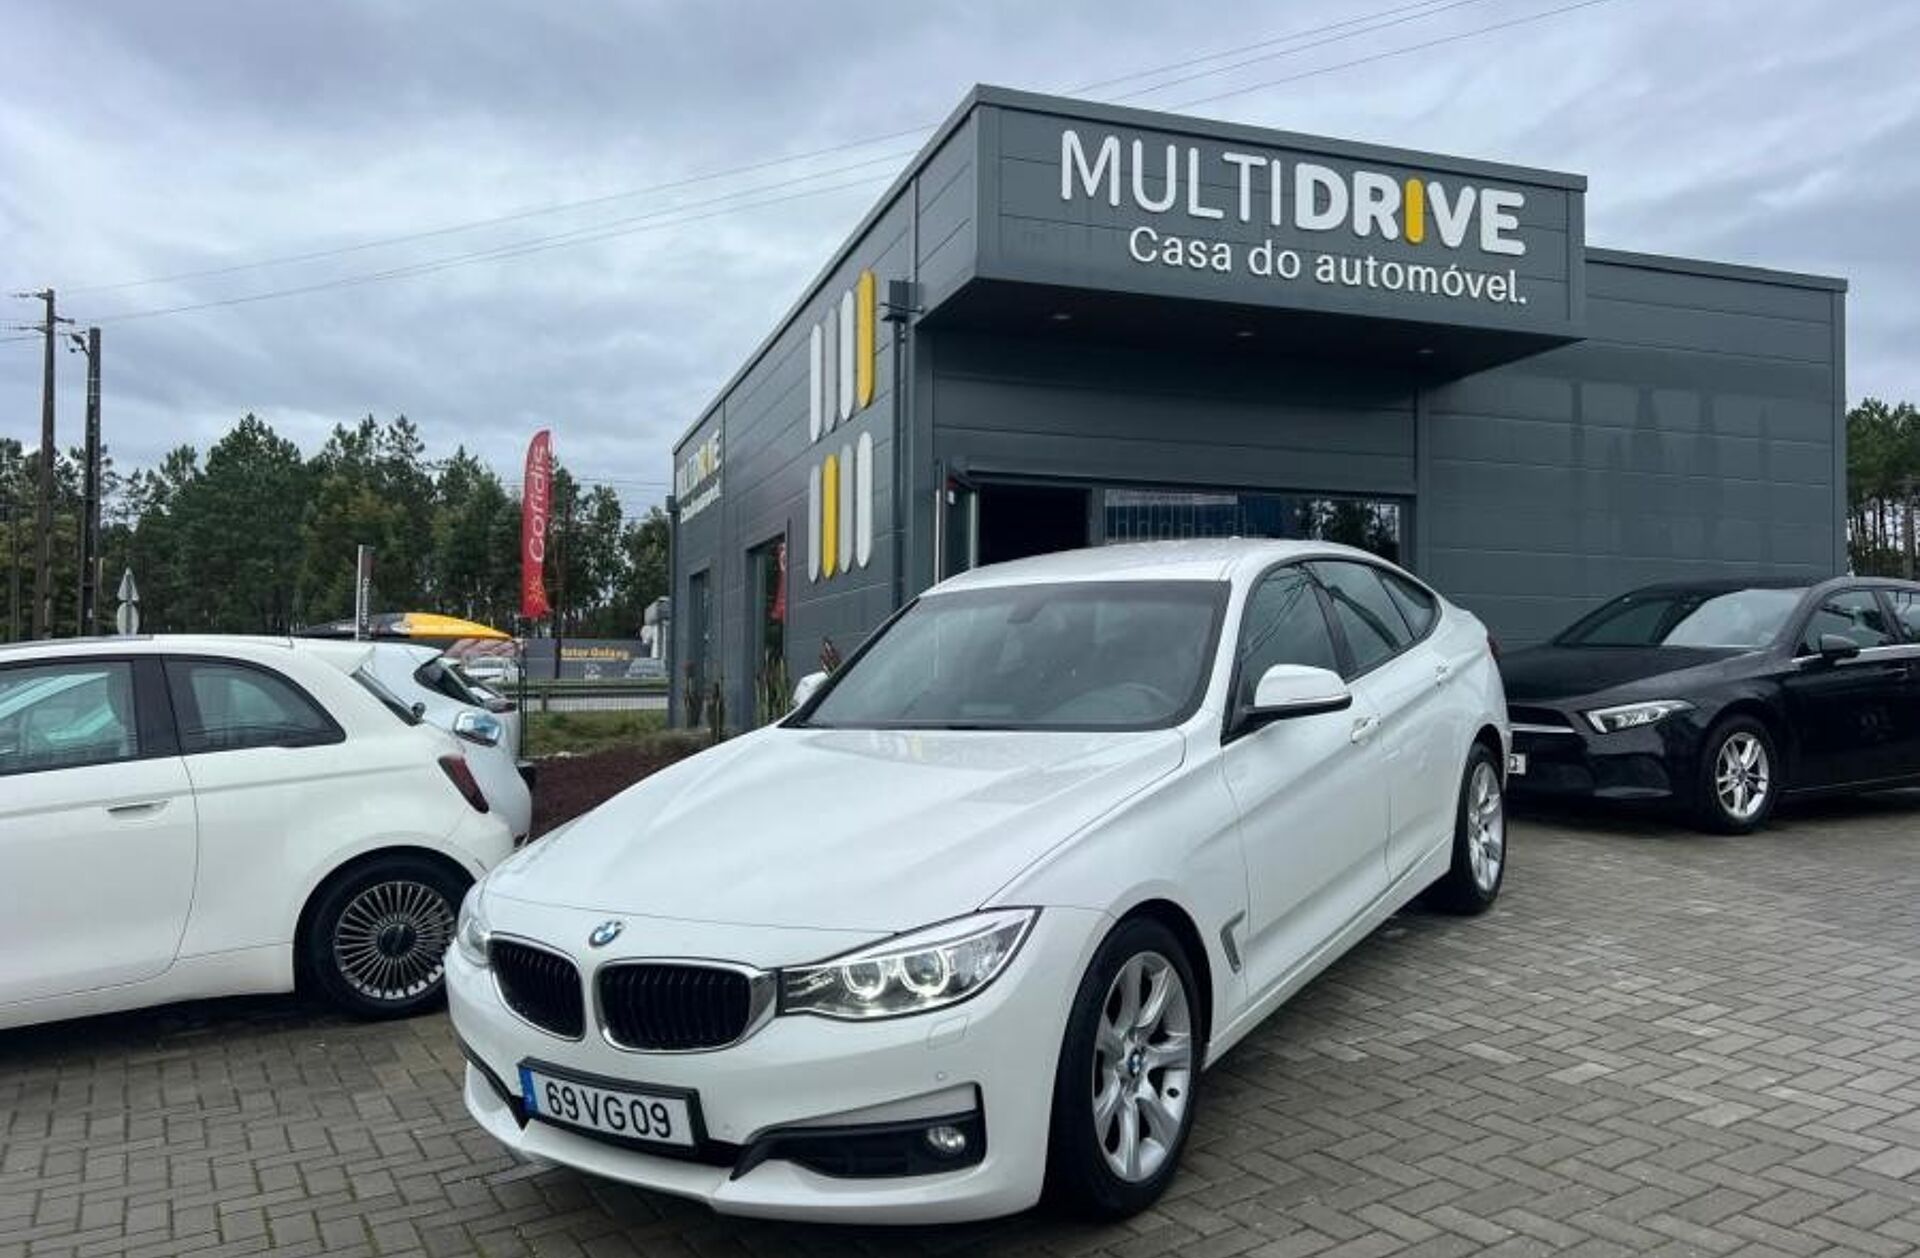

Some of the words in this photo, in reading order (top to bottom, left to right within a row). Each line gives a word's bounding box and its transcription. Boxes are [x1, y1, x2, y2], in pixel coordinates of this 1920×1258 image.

[1060, 129, 1526, 255] MULTIDRIVE
[1128, 226, 1233, 272] Casa
[1247, 239, 1301, 279] do
[1314, 254, 1528, 305] automóvel.
[528, 443, 546, 563] Cofidis
[544, 1080, 671, 1138] 69VG09
